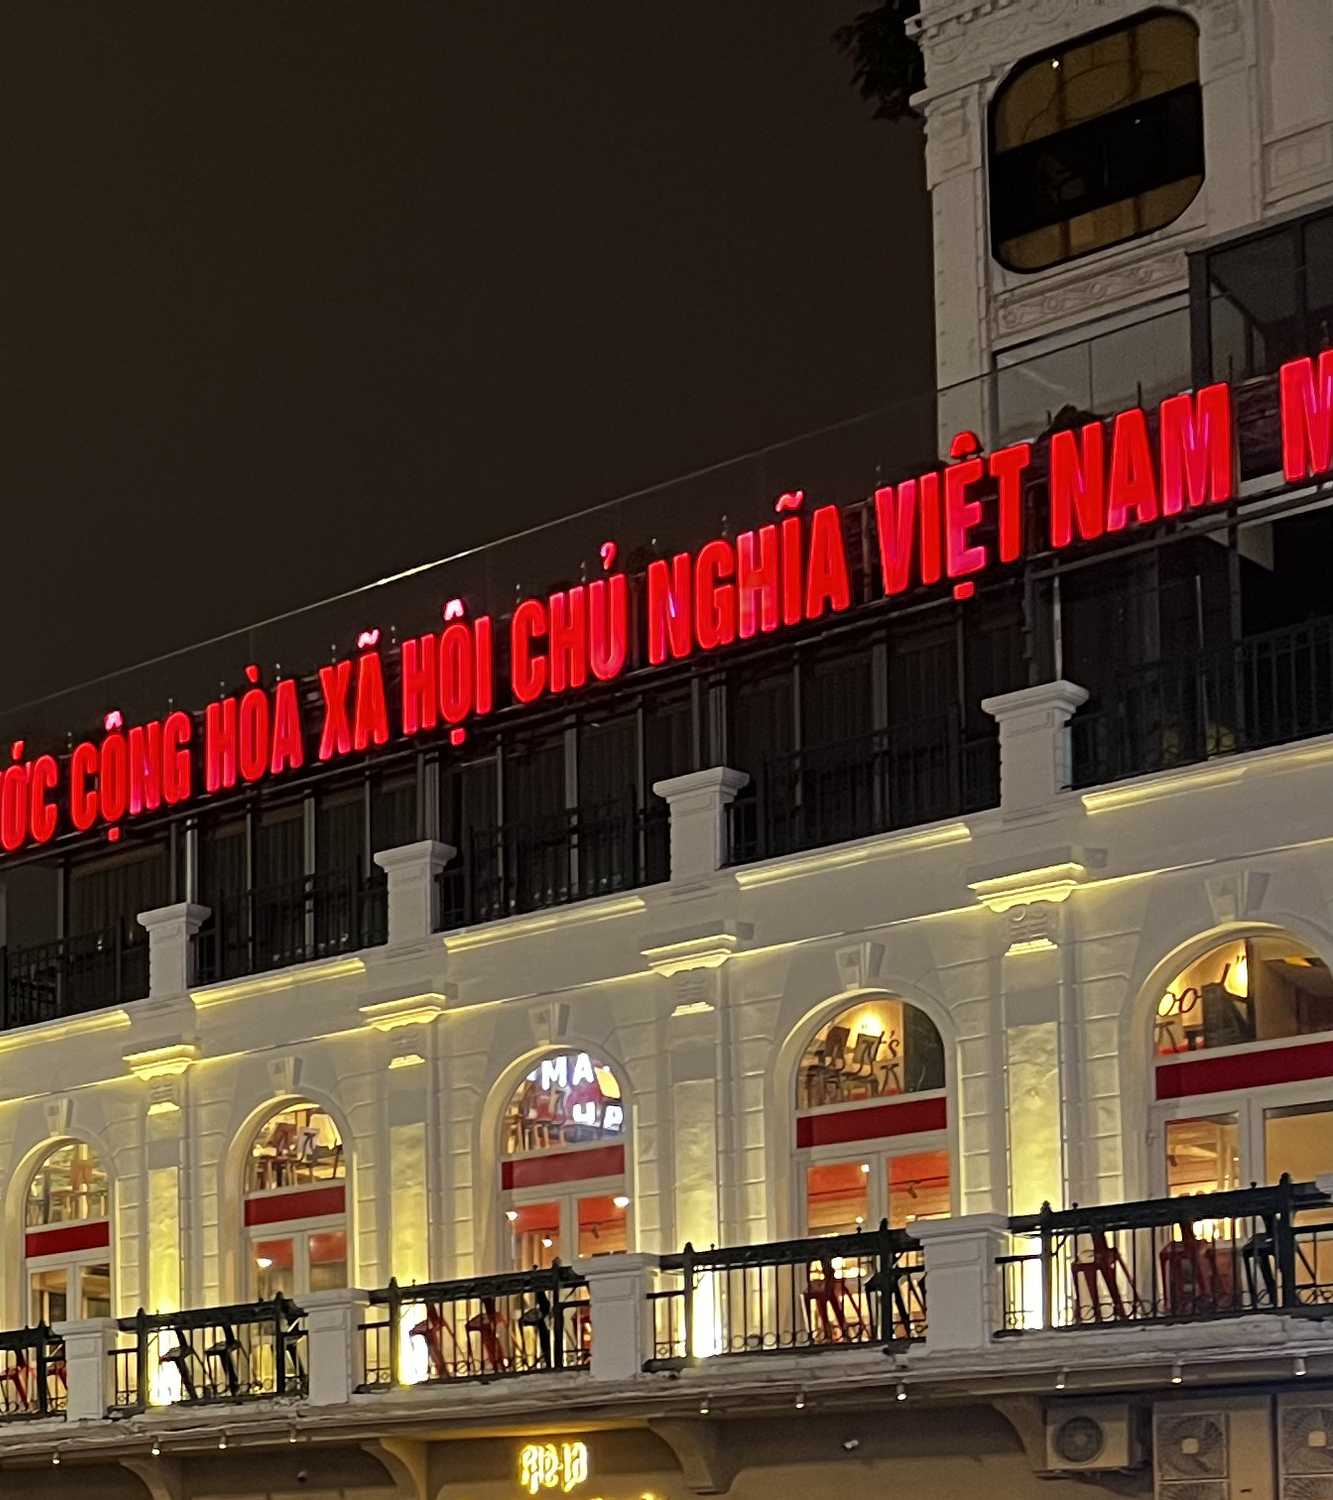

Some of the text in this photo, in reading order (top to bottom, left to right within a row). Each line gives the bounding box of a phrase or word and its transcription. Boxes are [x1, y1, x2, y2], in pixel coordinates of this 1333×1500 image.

[70, 710, 191, 842] CỘNG
[206, 665, 303, 793] HÒA
[319, 629, 389, 760] XÃ
[401, 598, 492, 746] HỘI
[511, 541, 628, 703] CHỦ
[647, 490, 850, 665] NGHĨA
[874, 430, 1031, 600] VIỆT
[1049, 382, 1231, 548] NAM
